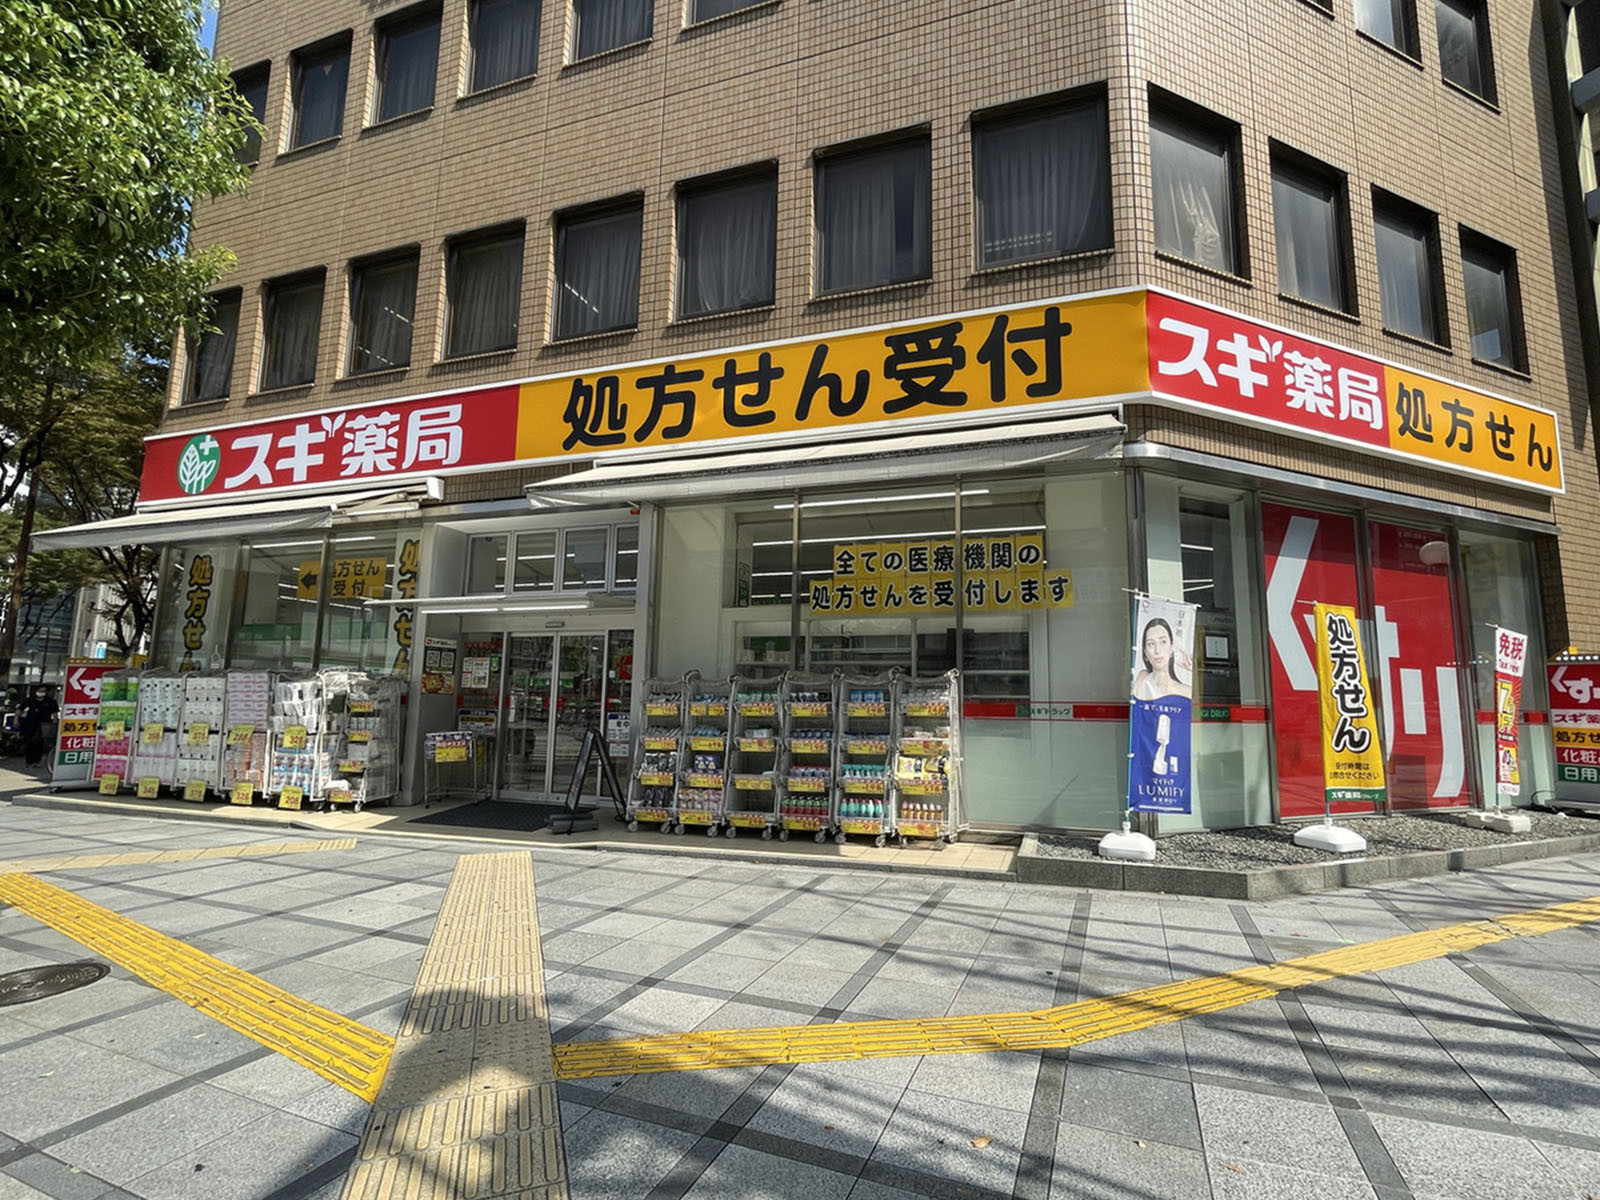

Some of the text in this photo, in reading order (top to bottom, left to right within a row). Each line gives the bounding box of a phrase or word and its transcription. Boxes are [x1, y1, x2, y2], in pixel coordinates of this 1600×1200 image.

[562, 307, 1072, 452] 処方せん受付
[1158, 317, 1383, 430] スギ薬局
[1396, 382, 1552, 472] 処方せん
[224, 404, 462, 489] スギ薬局
[332, 559, 379, 578] 方せん
[835, 542, 1041, 576] 全ての医療機関の
[333, 579, 366, 597] 受付
[811, 577, 1071, 610] 処方せんを受付します
[1499, 632, 1522, 660] 免税
[1328, 616, 1368, 750] 処方せん
[1551, 666, 1600, 704] くす
[65, 707, 98, 716] スギ
[63, 722, 97, 732] 処方
[1563, 749, 1600, 764] 化粧
[1564, 767, 1600, 782] 日用
[1138, 785, 1184, 797] LUMIFY
